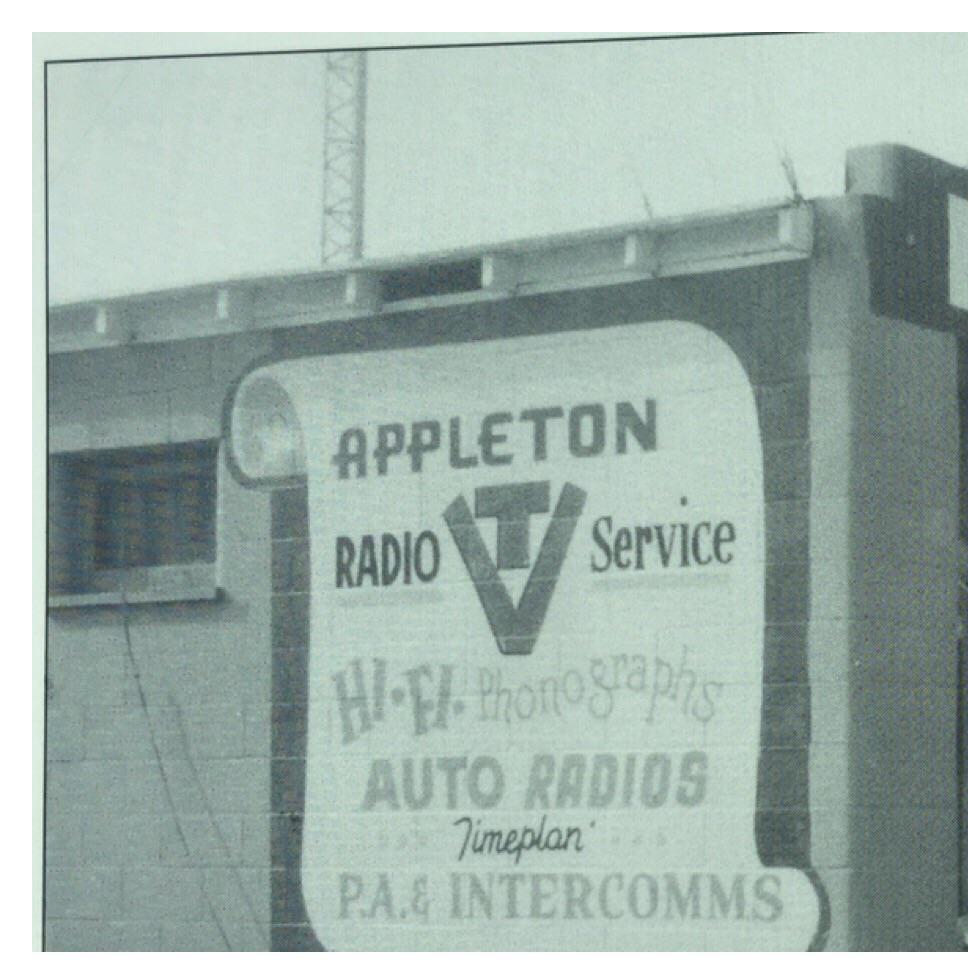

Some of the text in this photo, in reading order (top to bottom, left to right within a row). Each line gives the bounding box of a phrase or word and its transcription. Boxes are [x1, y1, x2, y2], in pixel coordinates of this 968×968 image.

[331, 398, 659, 480] APPLETON
[335, 530, 441, 589] RADIO
[590, 497, 737, 573] Service
[478, 643, 723, 725] Phonographs
[363, 750, 709, 812] AUTO RADIOS
[449, 870, 784, 923] INTERCOMMS
